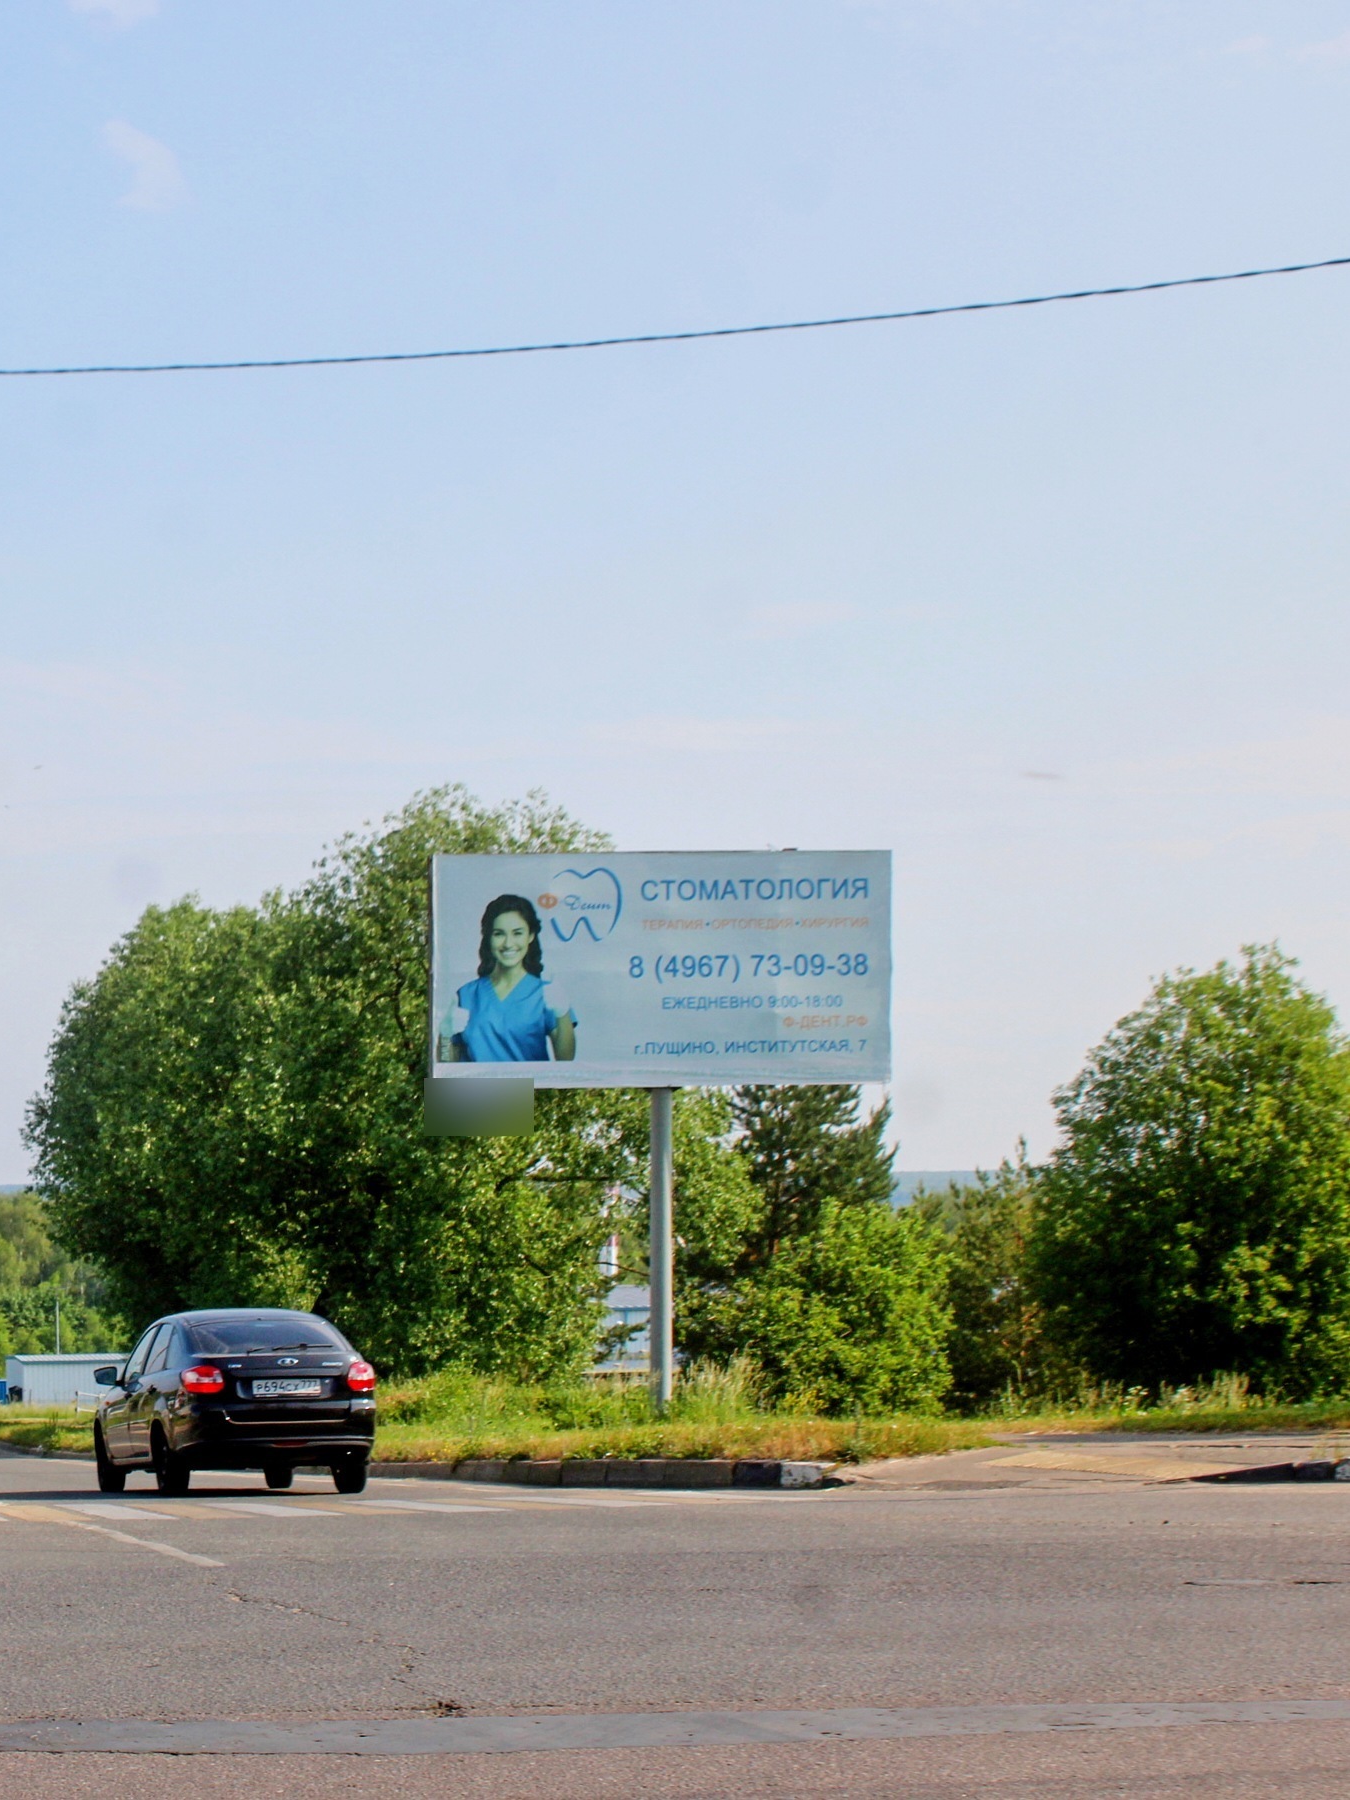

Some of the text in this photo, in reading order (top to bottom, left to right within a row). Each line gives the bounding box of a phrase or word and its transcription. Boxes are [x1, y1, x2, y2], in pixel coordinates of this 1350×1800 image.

[640, 878, 869, 901] СТОМАТОЛОГИЯ
[642, 917, 869, 931] ТЕРАПИЯ ОРТОПЕДИЯ ХИРУРГИЯ
[629, 953, 868, 984] 8 (4967) 73-09-38
[662, 995, 843, 1011] ЕЖЕДНЕВНО 9:00-18:00
[783, 1015, 868, 1029] Ф-ДЕНТ.РФ
[859, 1039, 867, 1051] 7
